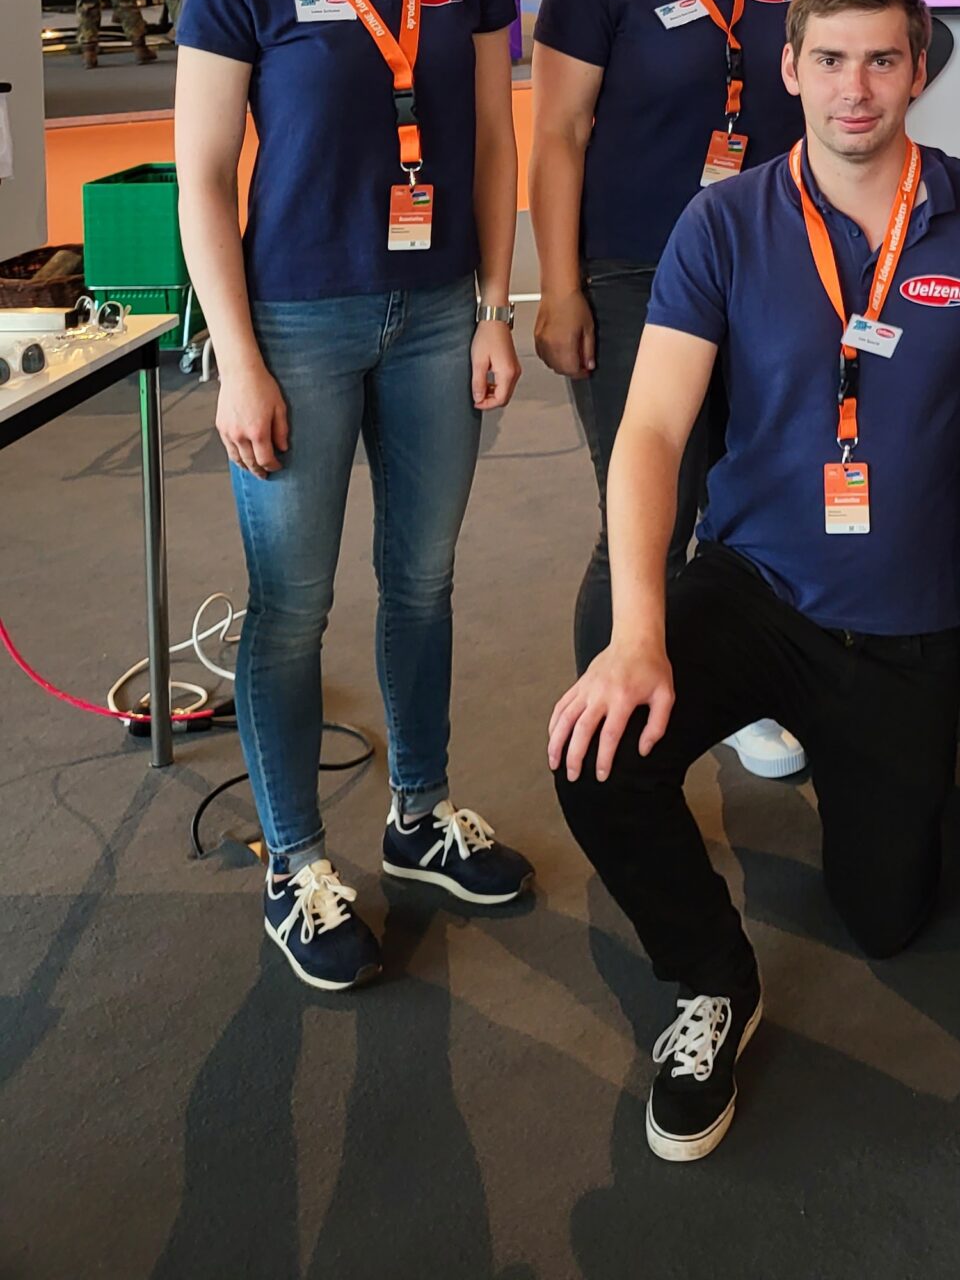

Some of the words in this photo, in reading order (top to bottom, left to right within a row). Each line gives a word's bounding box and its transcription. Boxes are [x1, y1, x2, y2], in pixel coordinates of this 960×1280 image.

[364, 11, 385, 37] DEINE
[879, 253, 893, 283] Ideen
[889, 203, 908, 251] verändern
